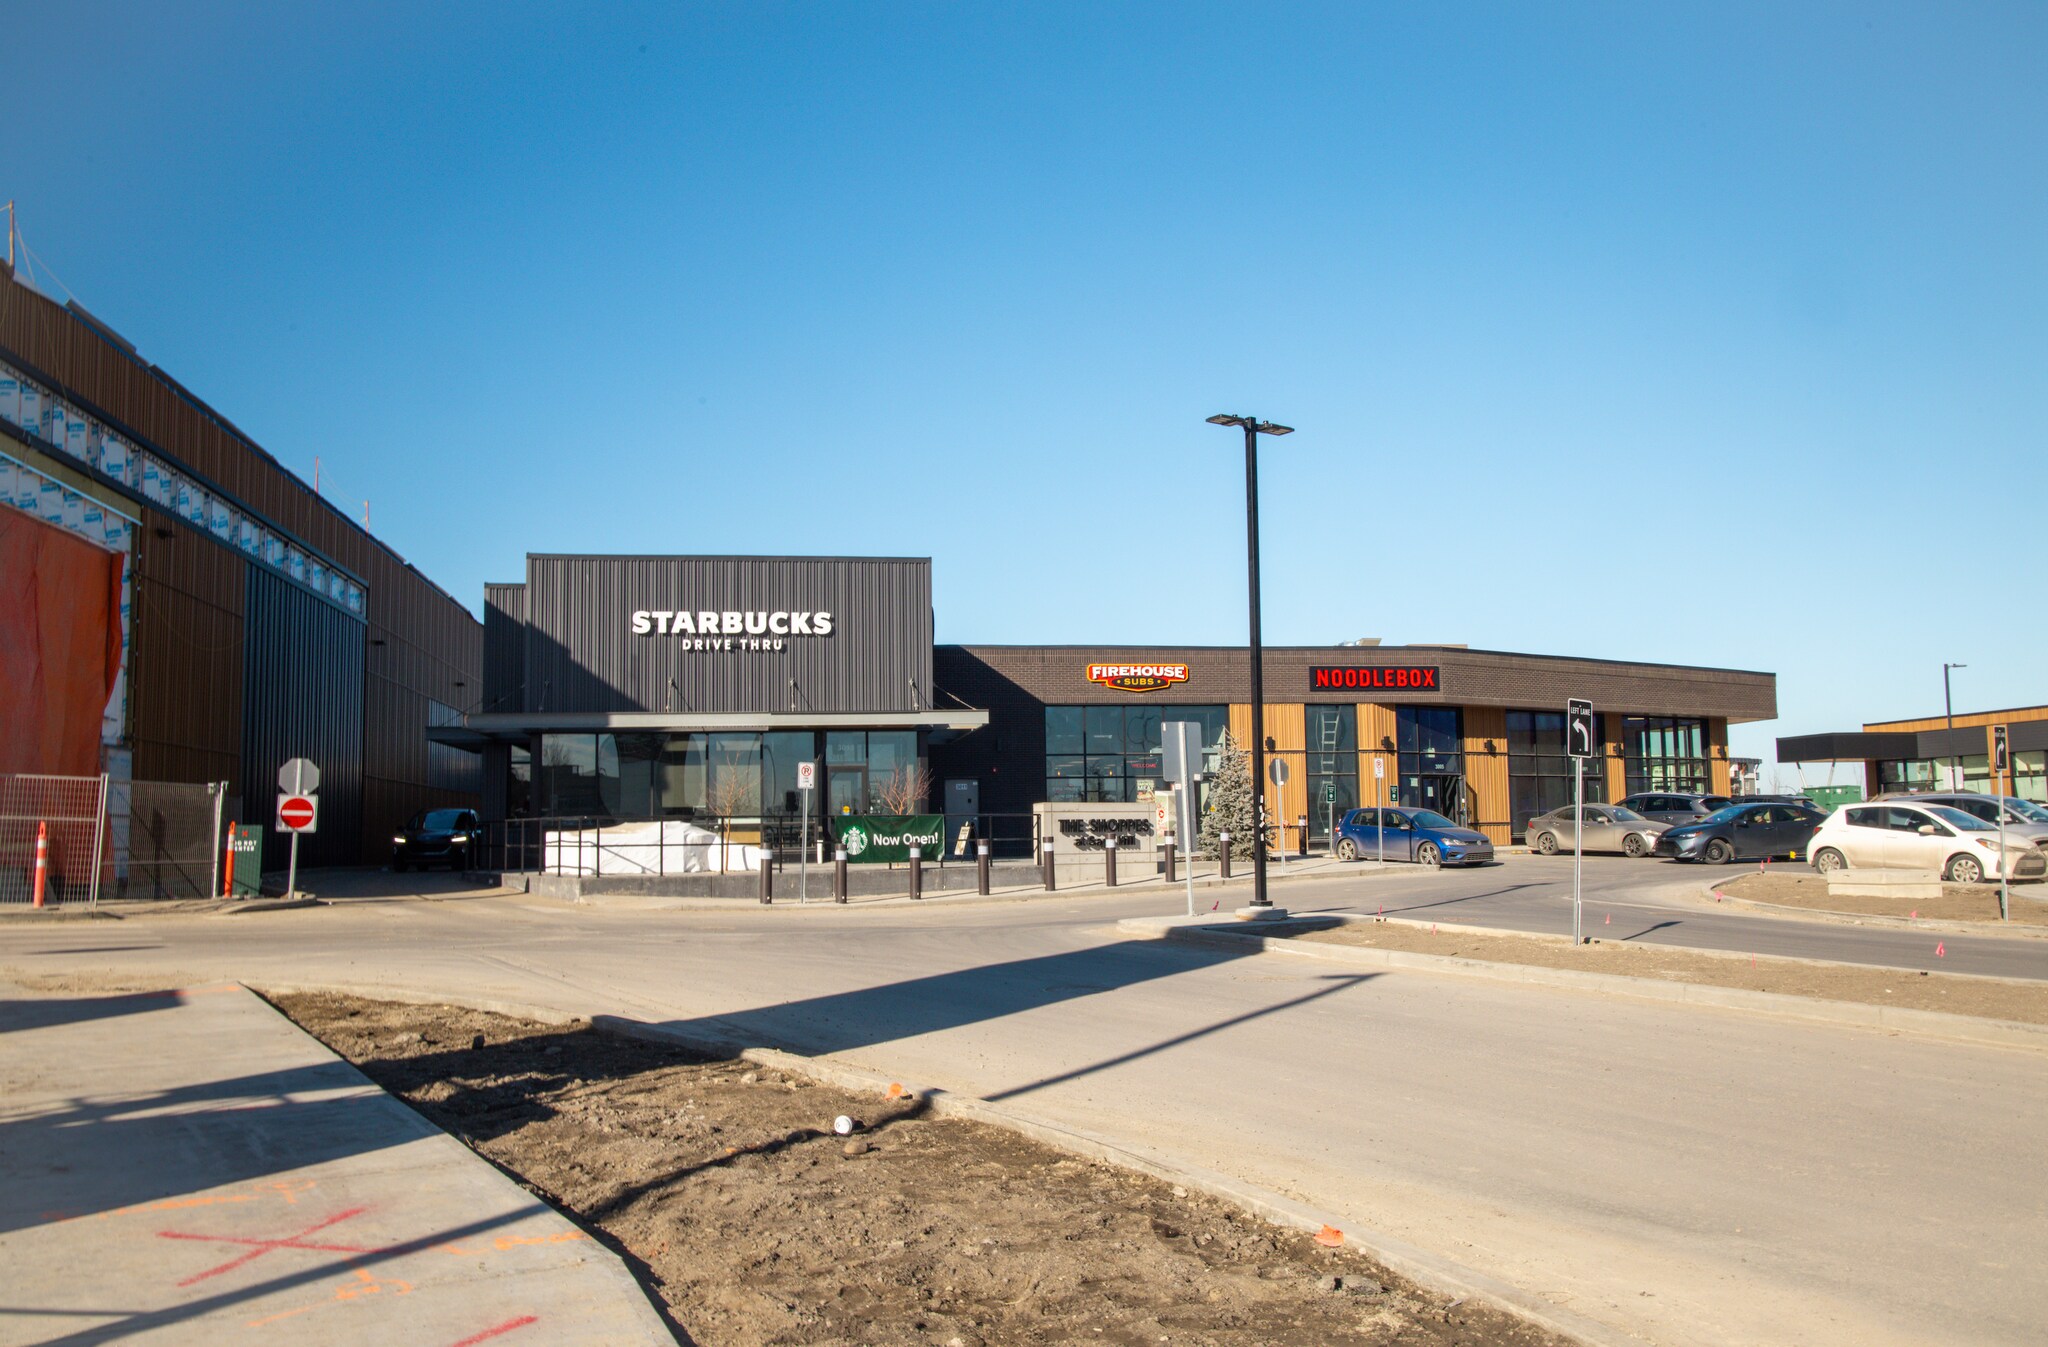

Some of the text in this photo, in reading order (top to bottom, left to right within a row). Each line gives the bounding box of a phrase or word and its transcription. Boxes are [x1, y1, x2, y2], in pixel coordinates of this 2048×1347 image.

[632, 610, 832, 635] STARBUCKS
[682, 639, 783, 651] DRIVE THRU
[1092, 666, 1185, 679] FIREHOUSE
[1317, 669, 1435, 687] NOODLEBOX
[1058, 819, 1085, 832] THE
[1089, 819, 1150, 832] SHOPPES
[873, 832, 938, 846] Now Open!
